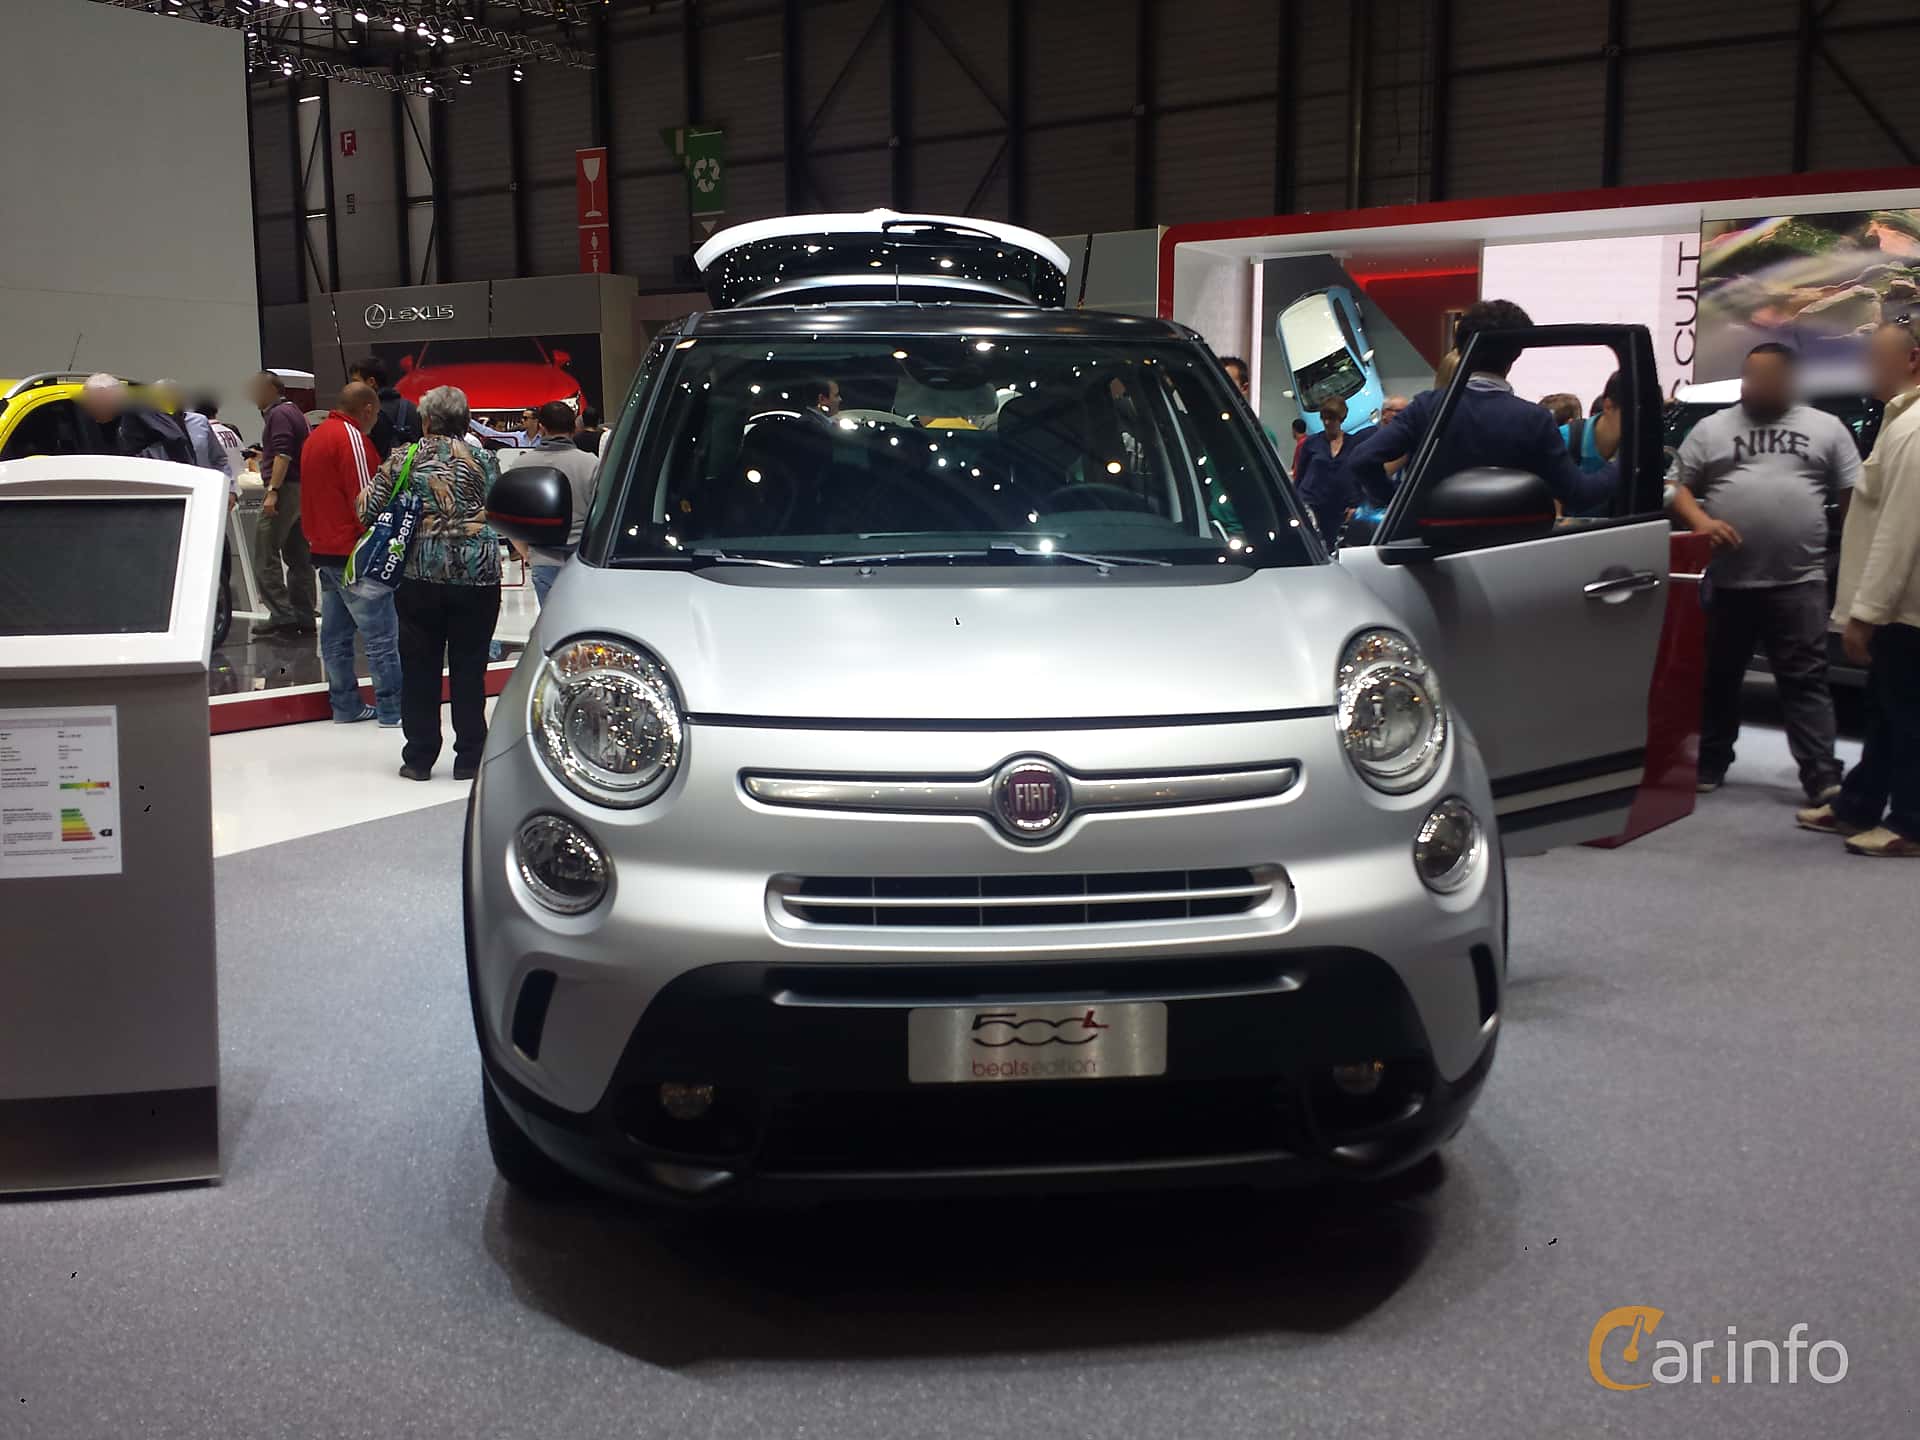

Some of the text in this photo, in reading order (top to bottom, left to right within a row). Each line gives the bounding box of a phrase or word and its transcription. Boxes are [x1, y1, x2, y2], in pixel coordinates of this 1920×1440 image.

[344, 132, 353, 151] F
[388, 304, 455, 322] LEXUS
[1732, 428, 1810, 463] NIKE
[1014, 782, 1051, 812] FIAT
